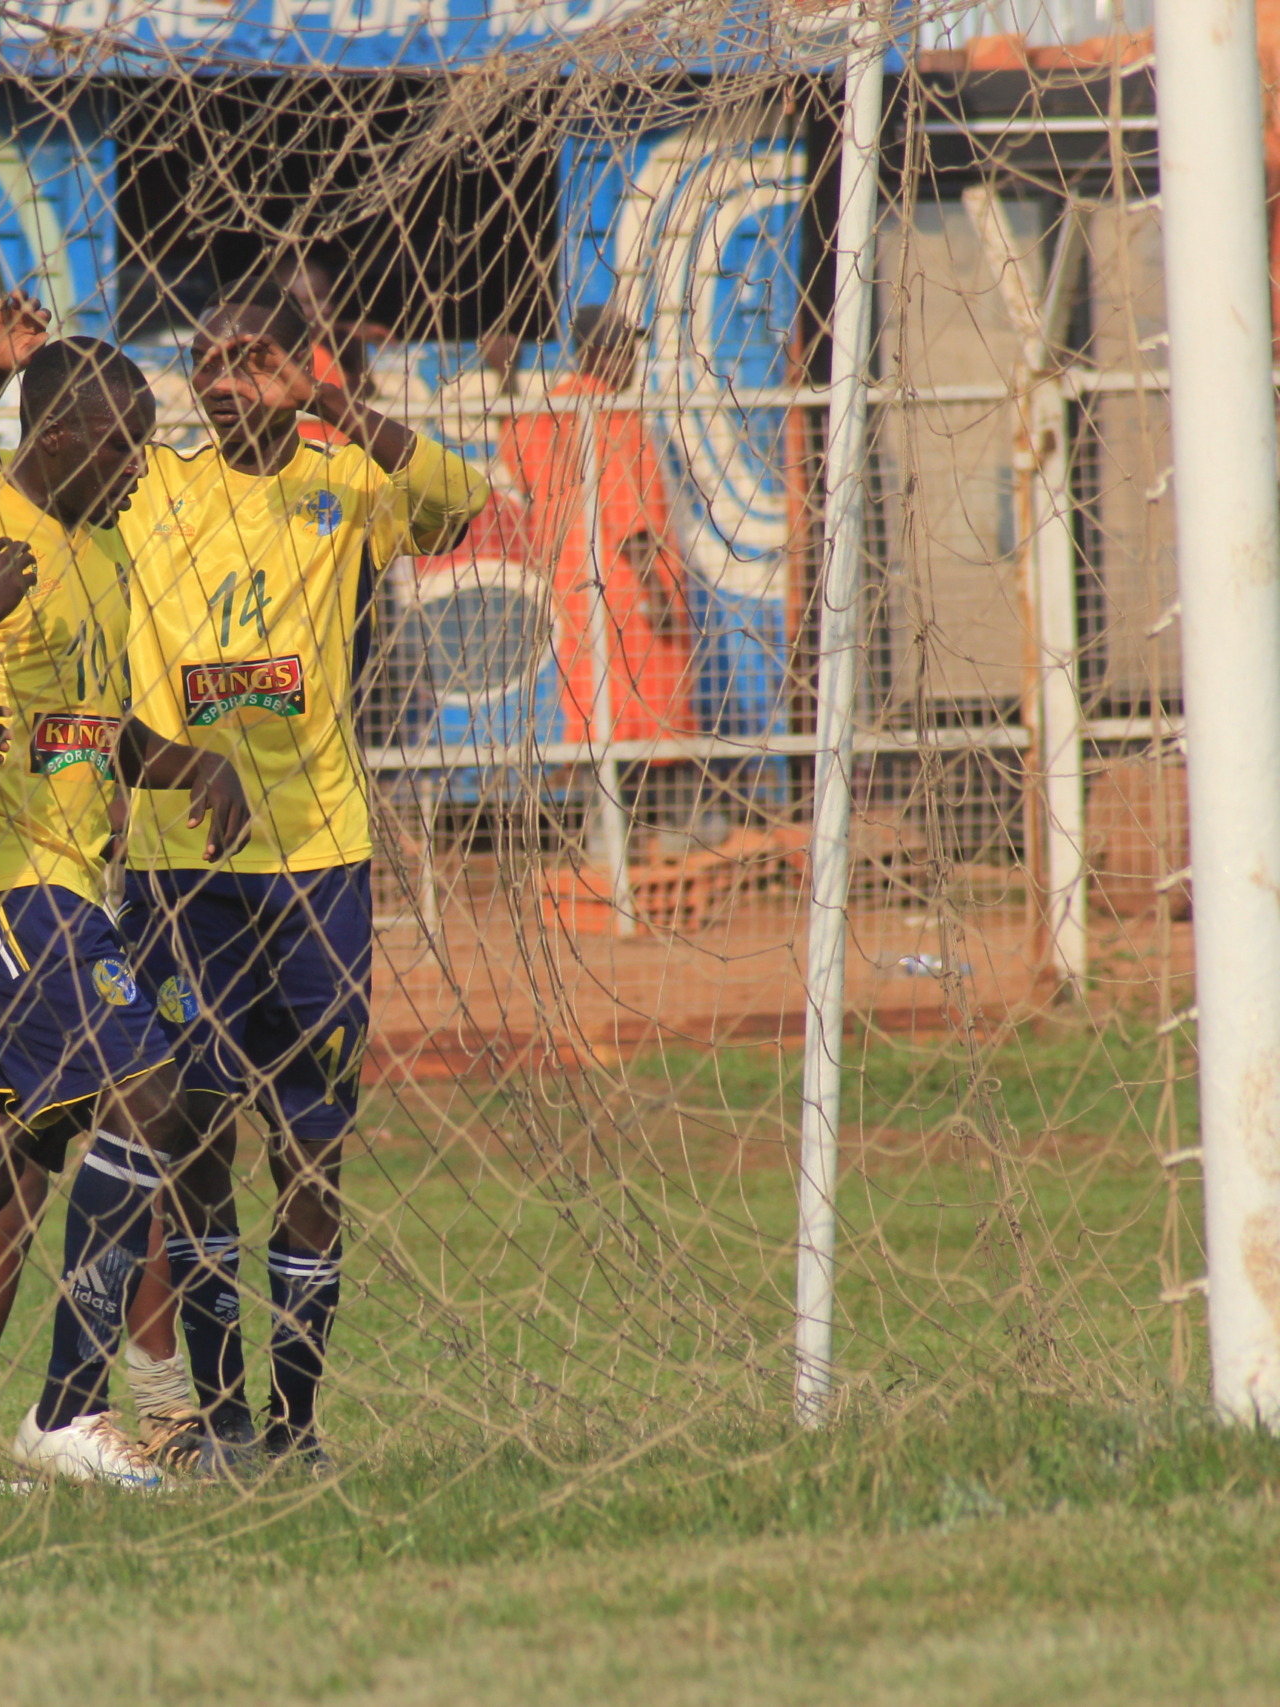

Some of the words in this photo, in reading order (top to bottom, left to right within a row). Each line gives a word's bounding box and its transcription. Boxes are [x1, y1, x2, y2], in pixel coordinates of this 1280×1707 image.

[208, 569, 272, 648] 14
[196, 664, 292, 695] KINGS
[202, 694, 258, 724] SPORTS
